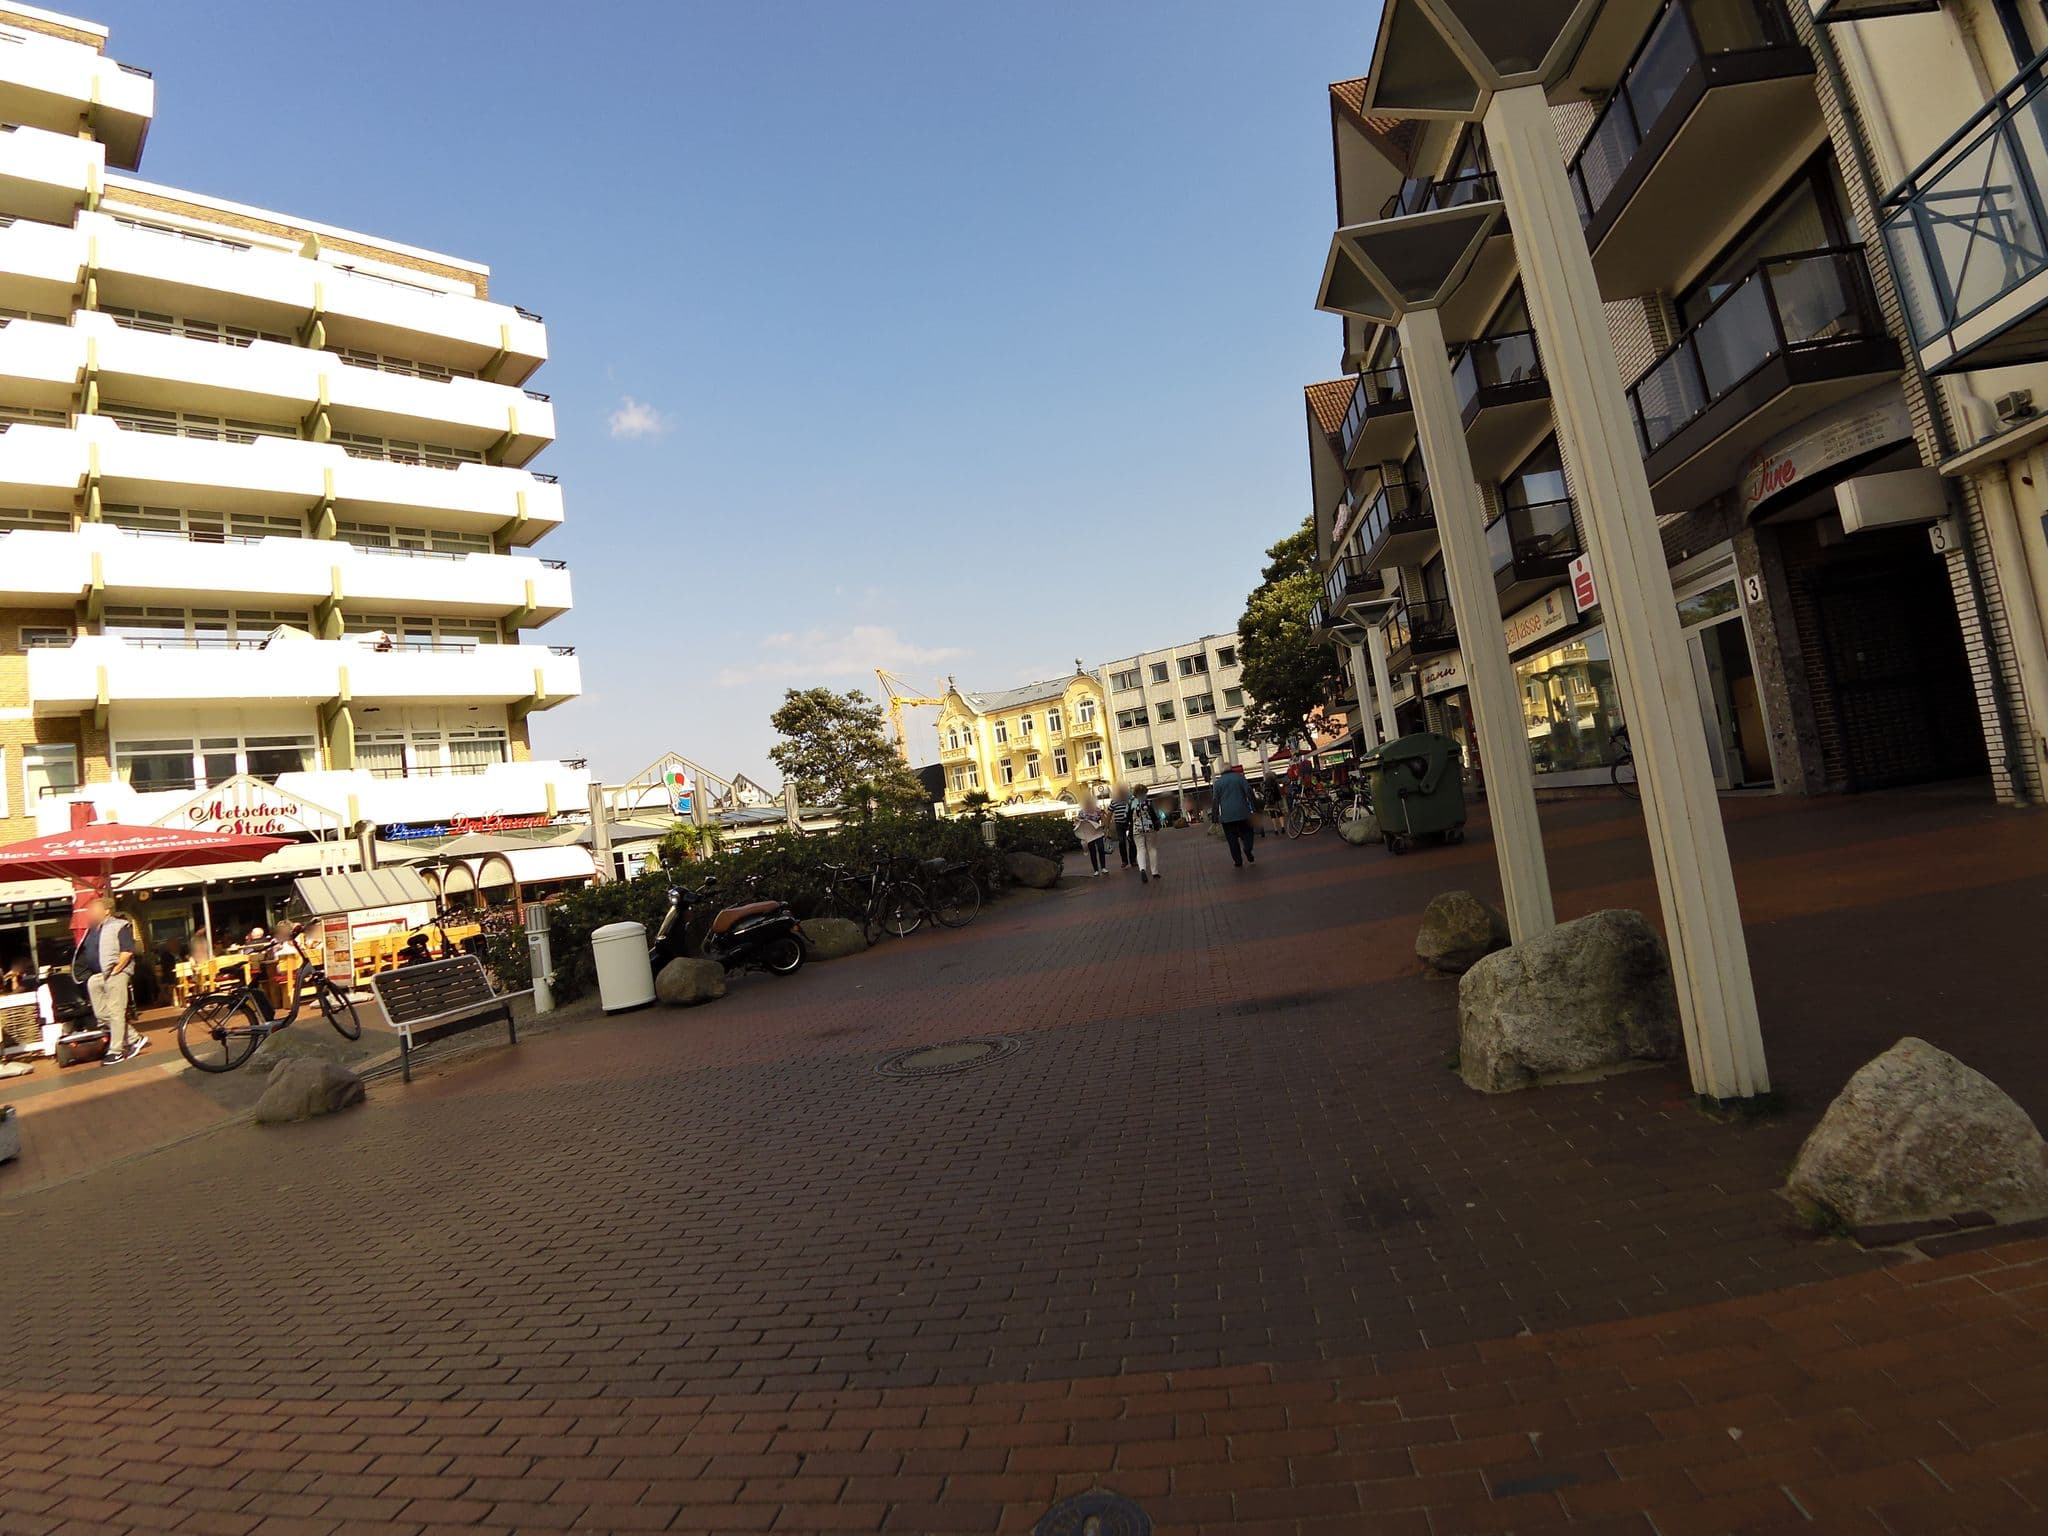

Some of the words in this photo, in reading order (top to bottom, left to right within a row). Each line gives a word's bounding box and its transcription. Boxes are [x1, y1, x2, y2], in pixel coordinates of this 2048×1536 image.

[1933, 527, 1946, 550] 3
[1749, 578, 1759, 600] 3
[189, 801, 298, 822] Metscher's
[216, 819, 285, 835] Stube
[78, 837, 230, 854] Schinkenstube
